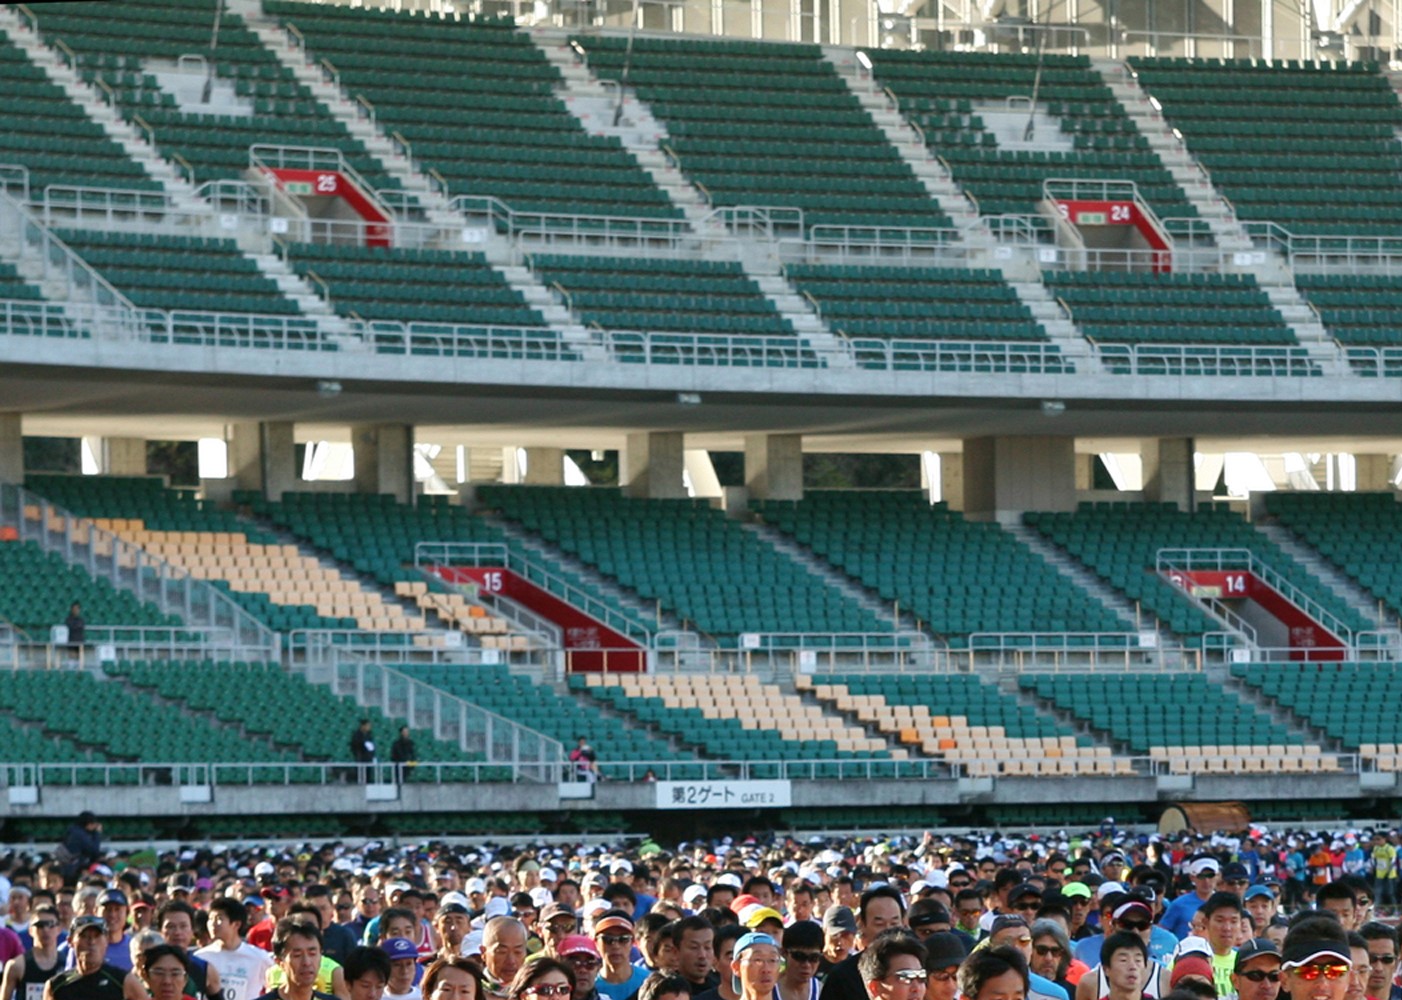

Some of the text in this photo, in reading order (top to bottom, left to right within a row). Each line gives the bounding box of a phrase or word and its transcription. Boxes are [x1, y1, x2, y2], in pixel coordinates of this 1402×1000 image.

[317, 174, 337, 192] 25
[1111, 206, 1130, 221] 24
[483, 572, 503, 591] 15
[1226, 576, 1245, 592] 14
[672, 785, 735, 804] 第2ゲート
[741, 793, 775, 804] GATE 2
